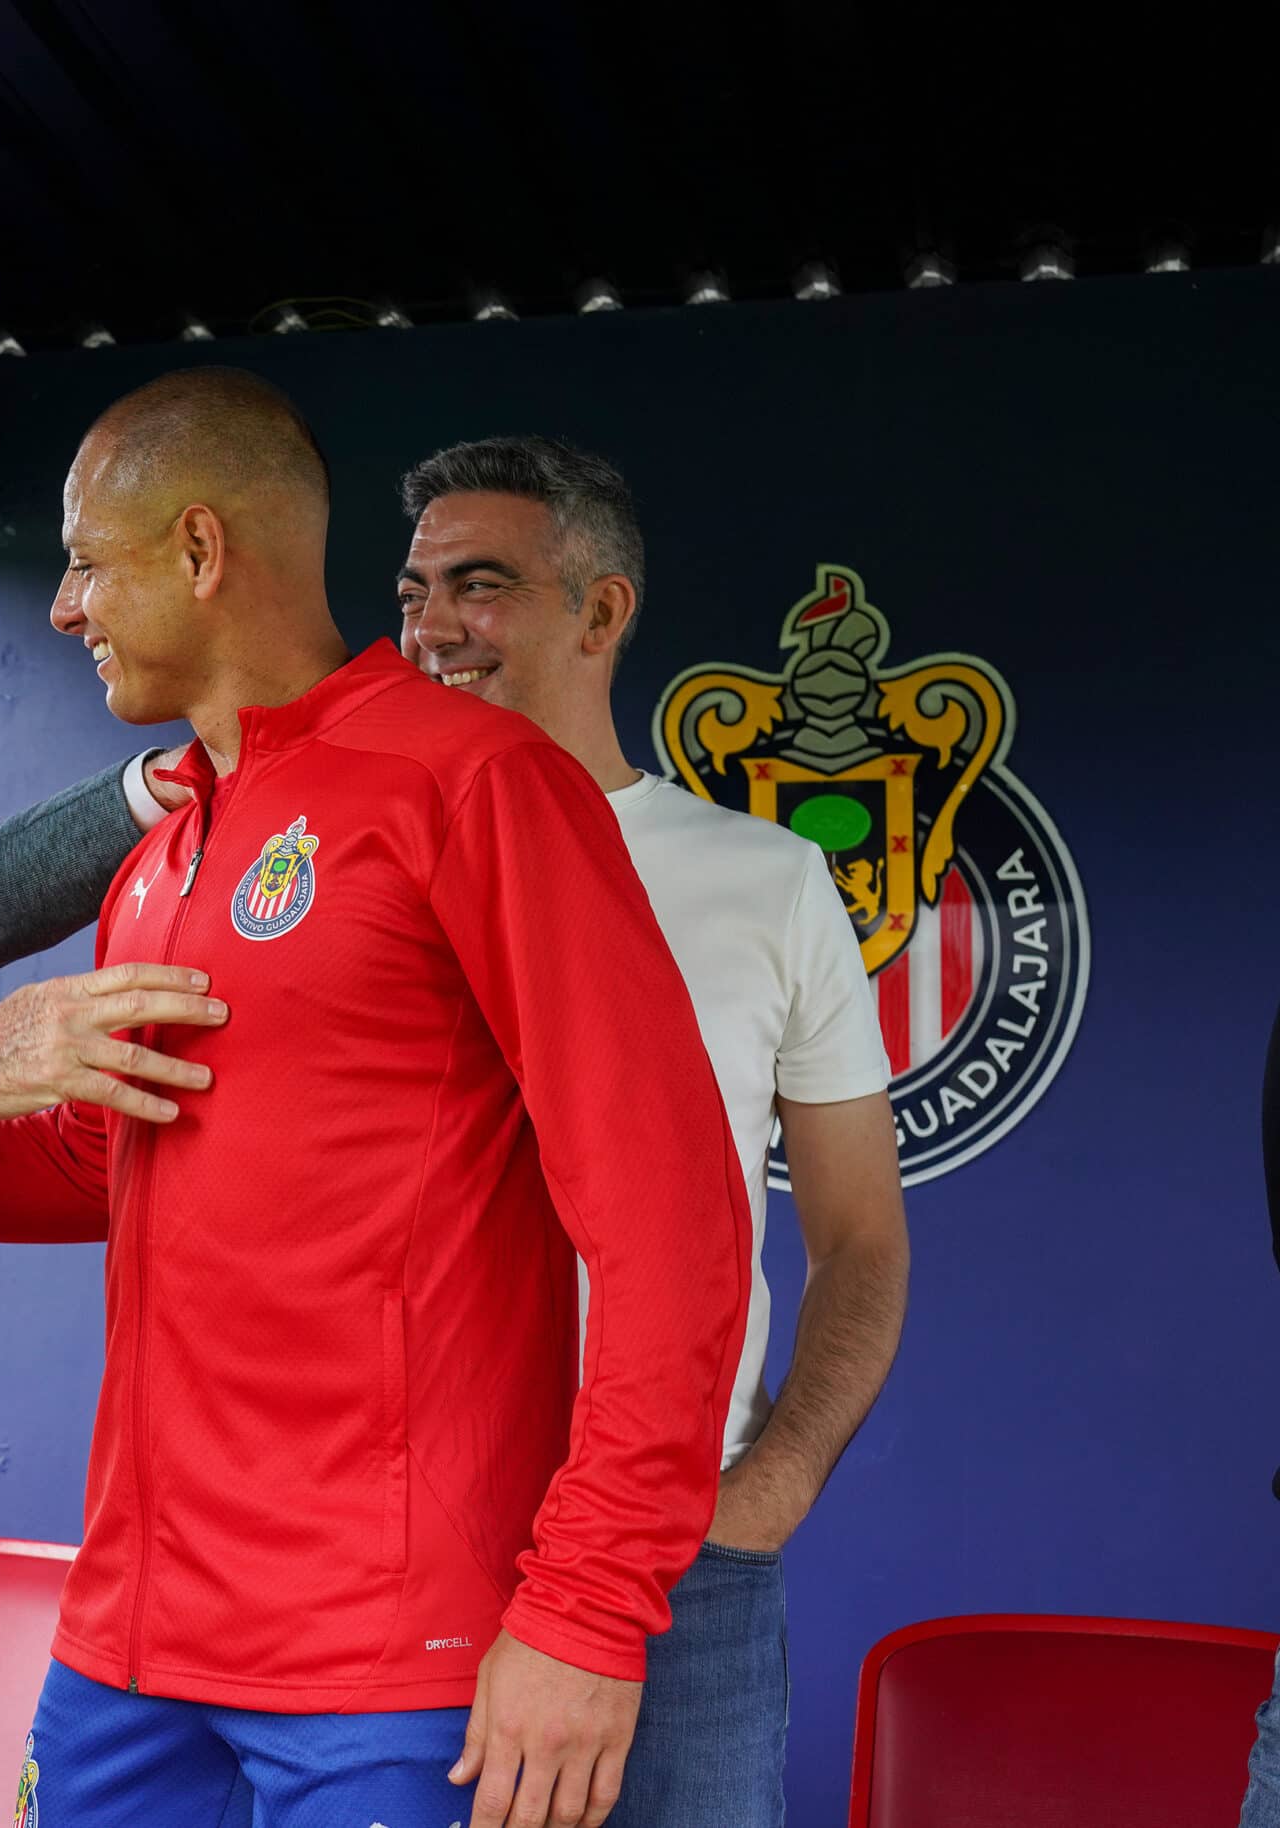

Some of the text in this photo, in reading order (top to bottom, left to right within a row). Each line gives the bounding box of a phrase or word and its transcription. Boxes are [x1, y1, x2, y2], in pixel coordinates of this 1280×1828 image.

[237, 898, 264, 932] DEPORTIVO
[265, 874, 310, 932] GUADALAJARA
[425, 1636, 473, 1651] DRYCELL
